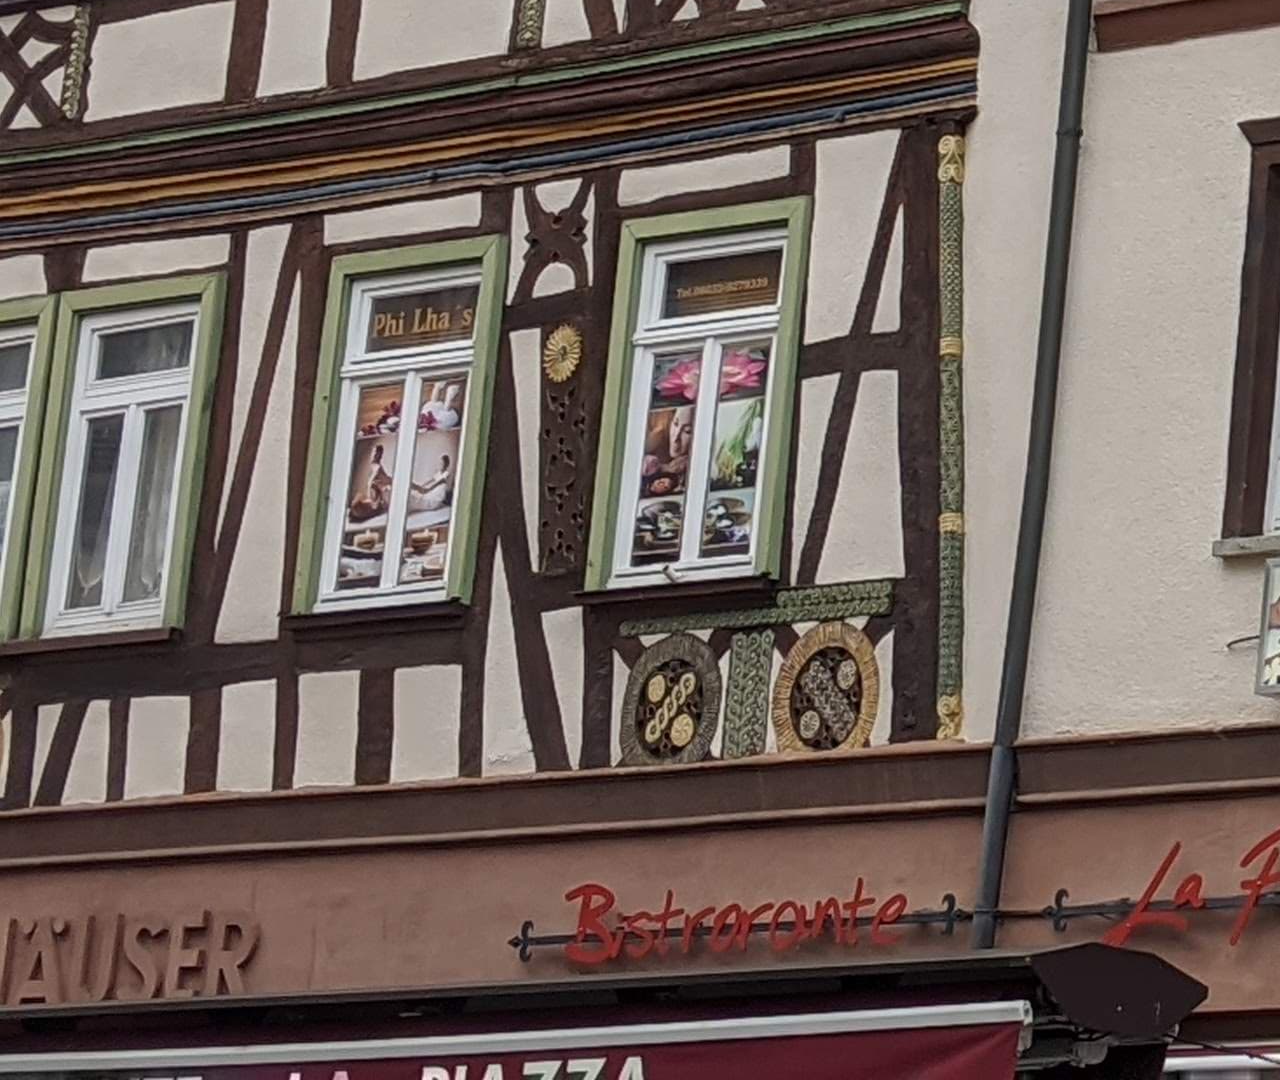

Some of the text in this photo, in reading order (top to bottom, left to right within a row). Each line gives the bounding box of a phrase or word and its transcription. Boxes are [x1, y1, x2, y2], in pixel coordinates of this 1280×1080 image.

[373, 311, 406, 338] Phi
[564, 877, 909, 964] Bistrorante
[1104, 841, 1206, 946] La
[0, 910, 261, 1007] ÄUSER
